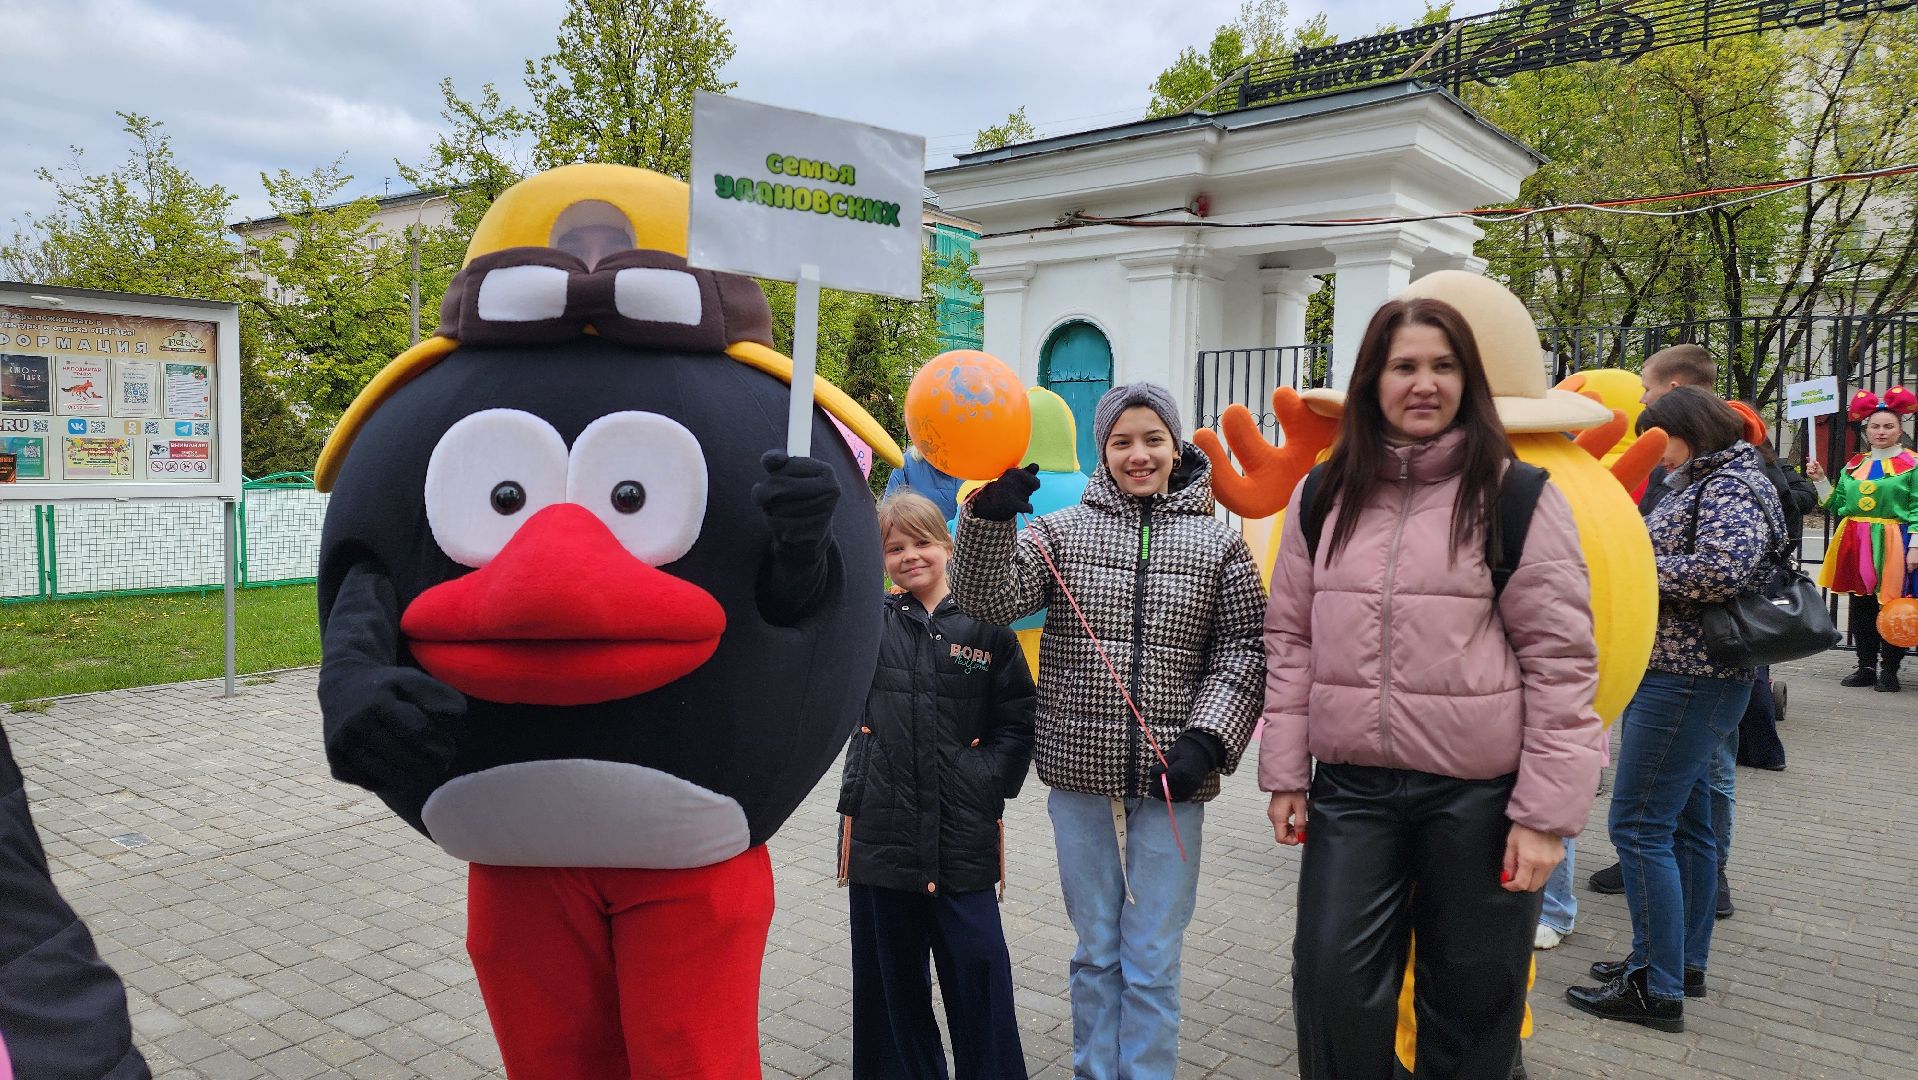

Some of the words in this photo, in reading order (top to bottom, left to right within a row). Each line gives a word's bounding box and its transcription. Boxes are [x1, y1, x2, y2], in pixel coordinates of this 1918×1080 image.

[766, 153, 856, 185] семья
[714, 173, 901, 227] УЛАНОВСКИХ
[35, 315, 94, 325] пожаловать
[950, 643, 993, 666] BORN
